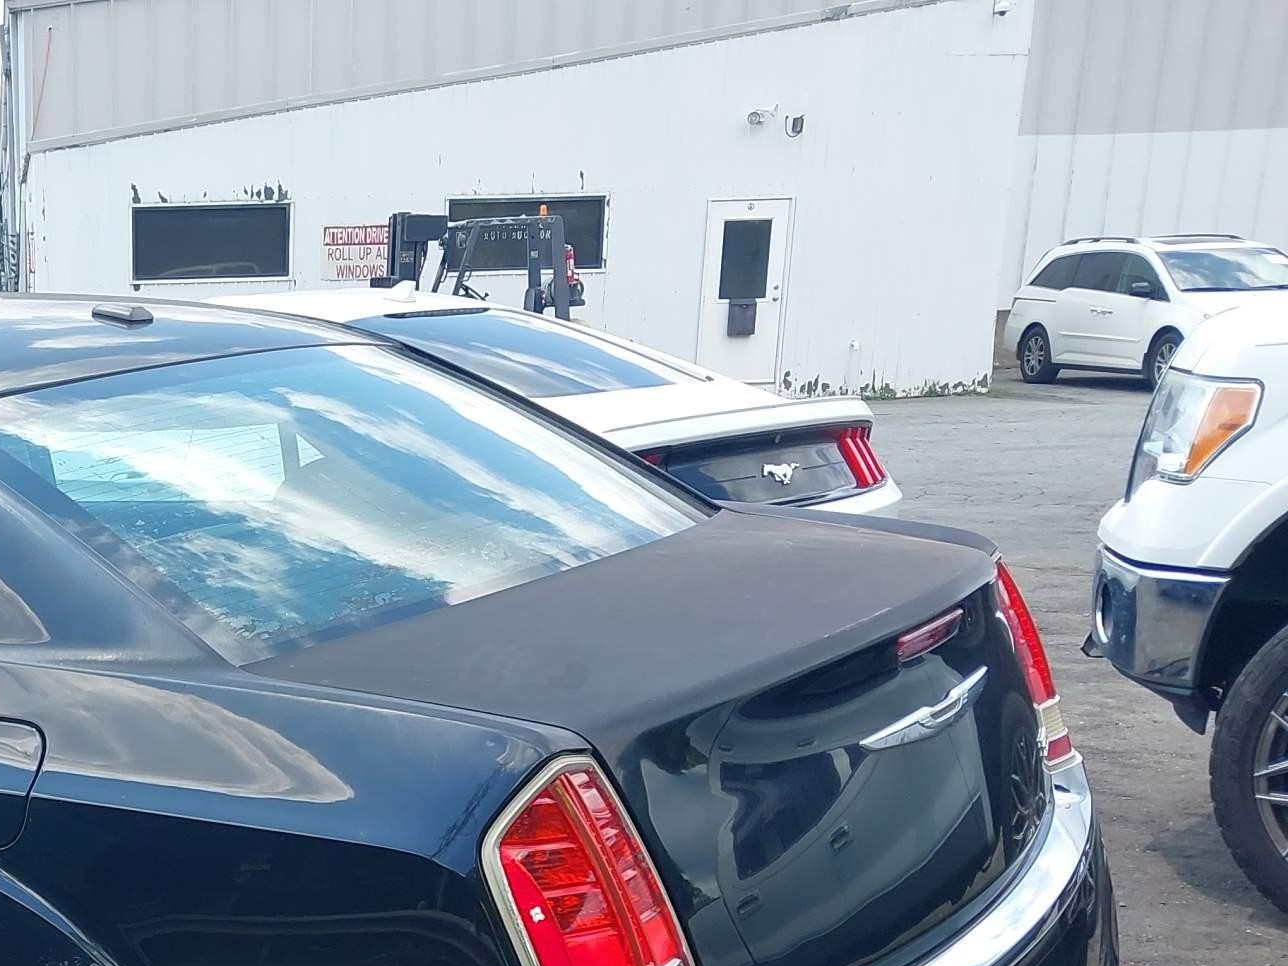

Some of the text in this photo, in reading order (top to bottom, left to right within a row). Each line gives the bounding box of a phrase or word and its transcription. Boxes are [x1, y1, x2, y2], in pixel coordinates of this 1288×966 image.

[324, 227, 389, 244] ATTENTION DRIVE
[327, 247, 353, 261] ROLL
[358, 247, 372, 260] UP
[375, 246, 388, 260] AL
[335, 264, 385, 278] WINDOWS
